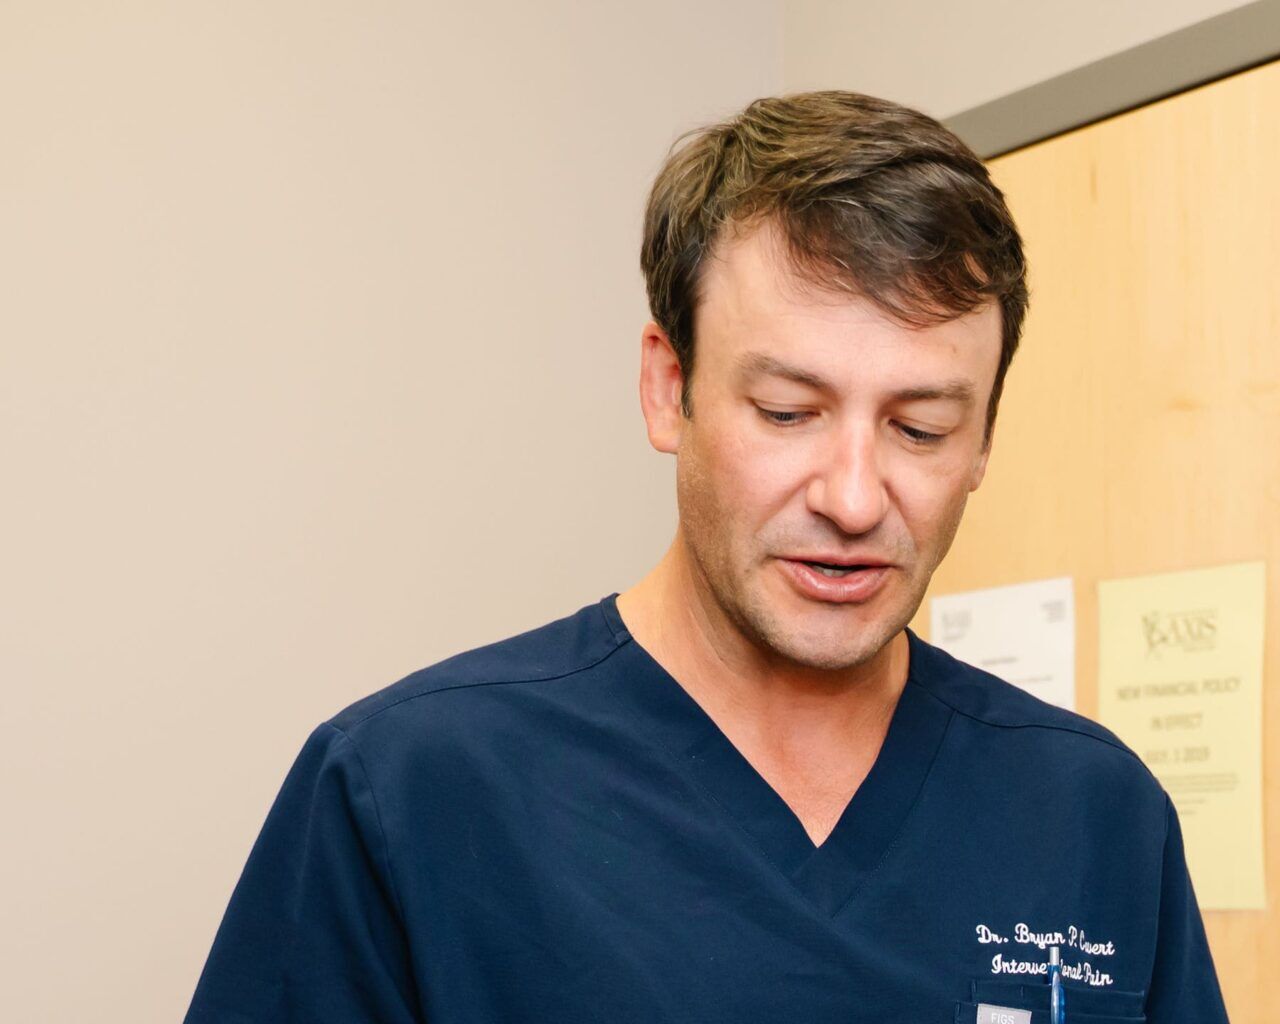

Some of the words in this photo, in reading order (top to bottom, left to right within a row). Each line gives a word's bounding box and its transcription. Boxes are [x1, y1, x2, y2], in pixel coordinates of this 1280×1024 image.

[1202, 676, 1241, 694] POLICY
[975, 924, 1009, 944] Dr.
[1015, 922, 1066, 950] Bryan
[991, 954, 1084, 981] Interveonal
